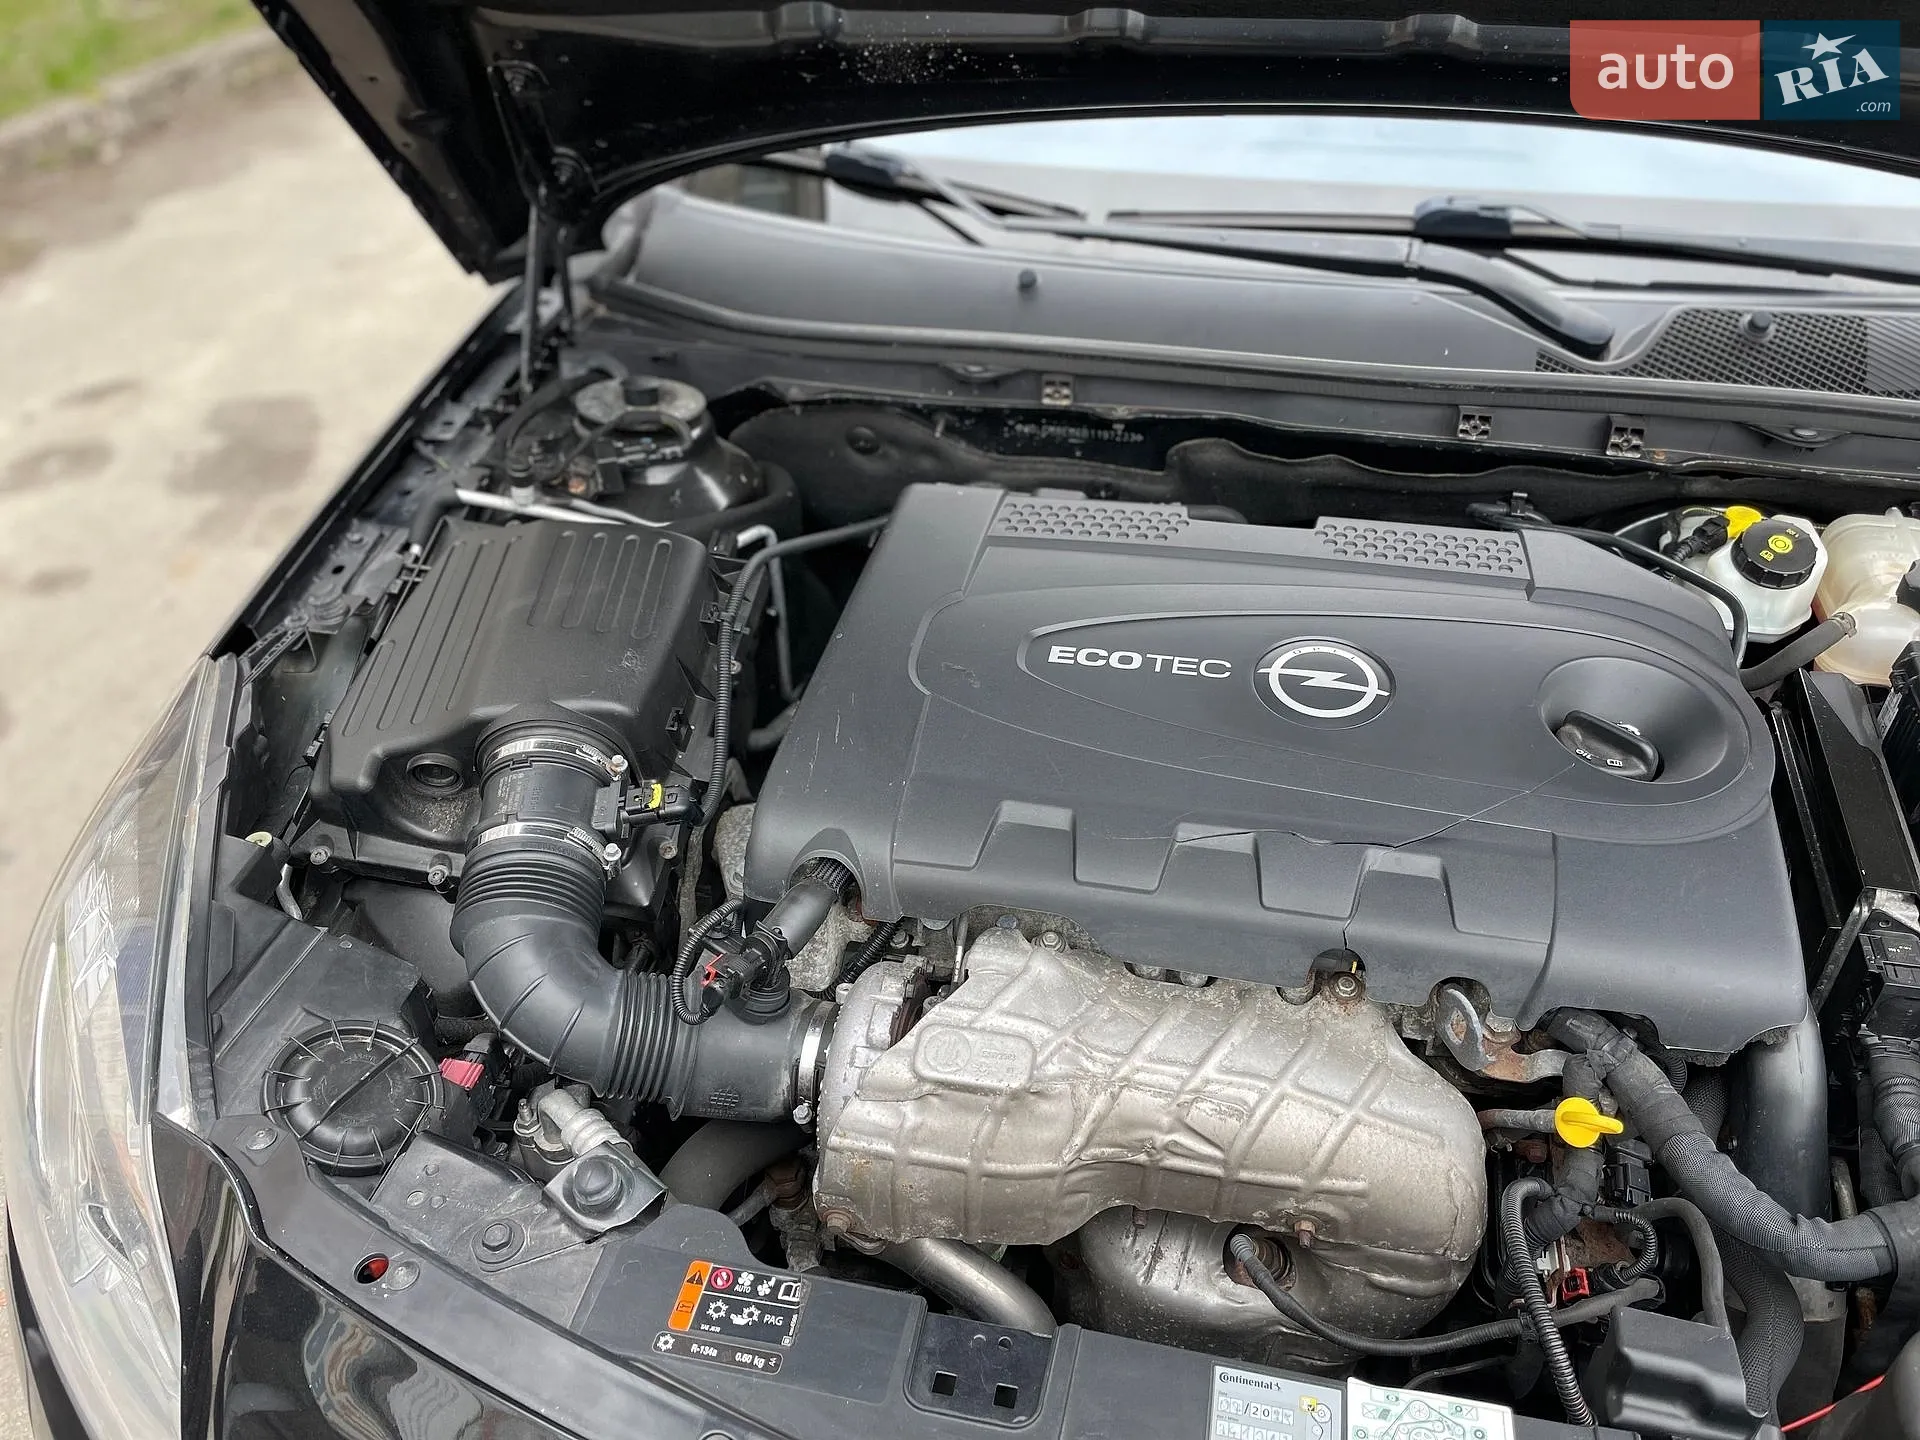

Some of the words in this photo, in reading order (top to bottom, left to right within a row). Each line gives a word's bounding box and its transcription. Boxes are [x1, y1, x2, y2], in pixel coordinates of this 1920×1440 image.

[1047, 645, 1233, 679] ECOTEC
[733, 1284, 751, 1294] AUTO
[763, 1313, 784, 1327] PAG
[690, 1343, 718, 1357] R-134a
[753, 1355, 766, 1369] kg
[1219, 1371, 1273, 1390] Continental
